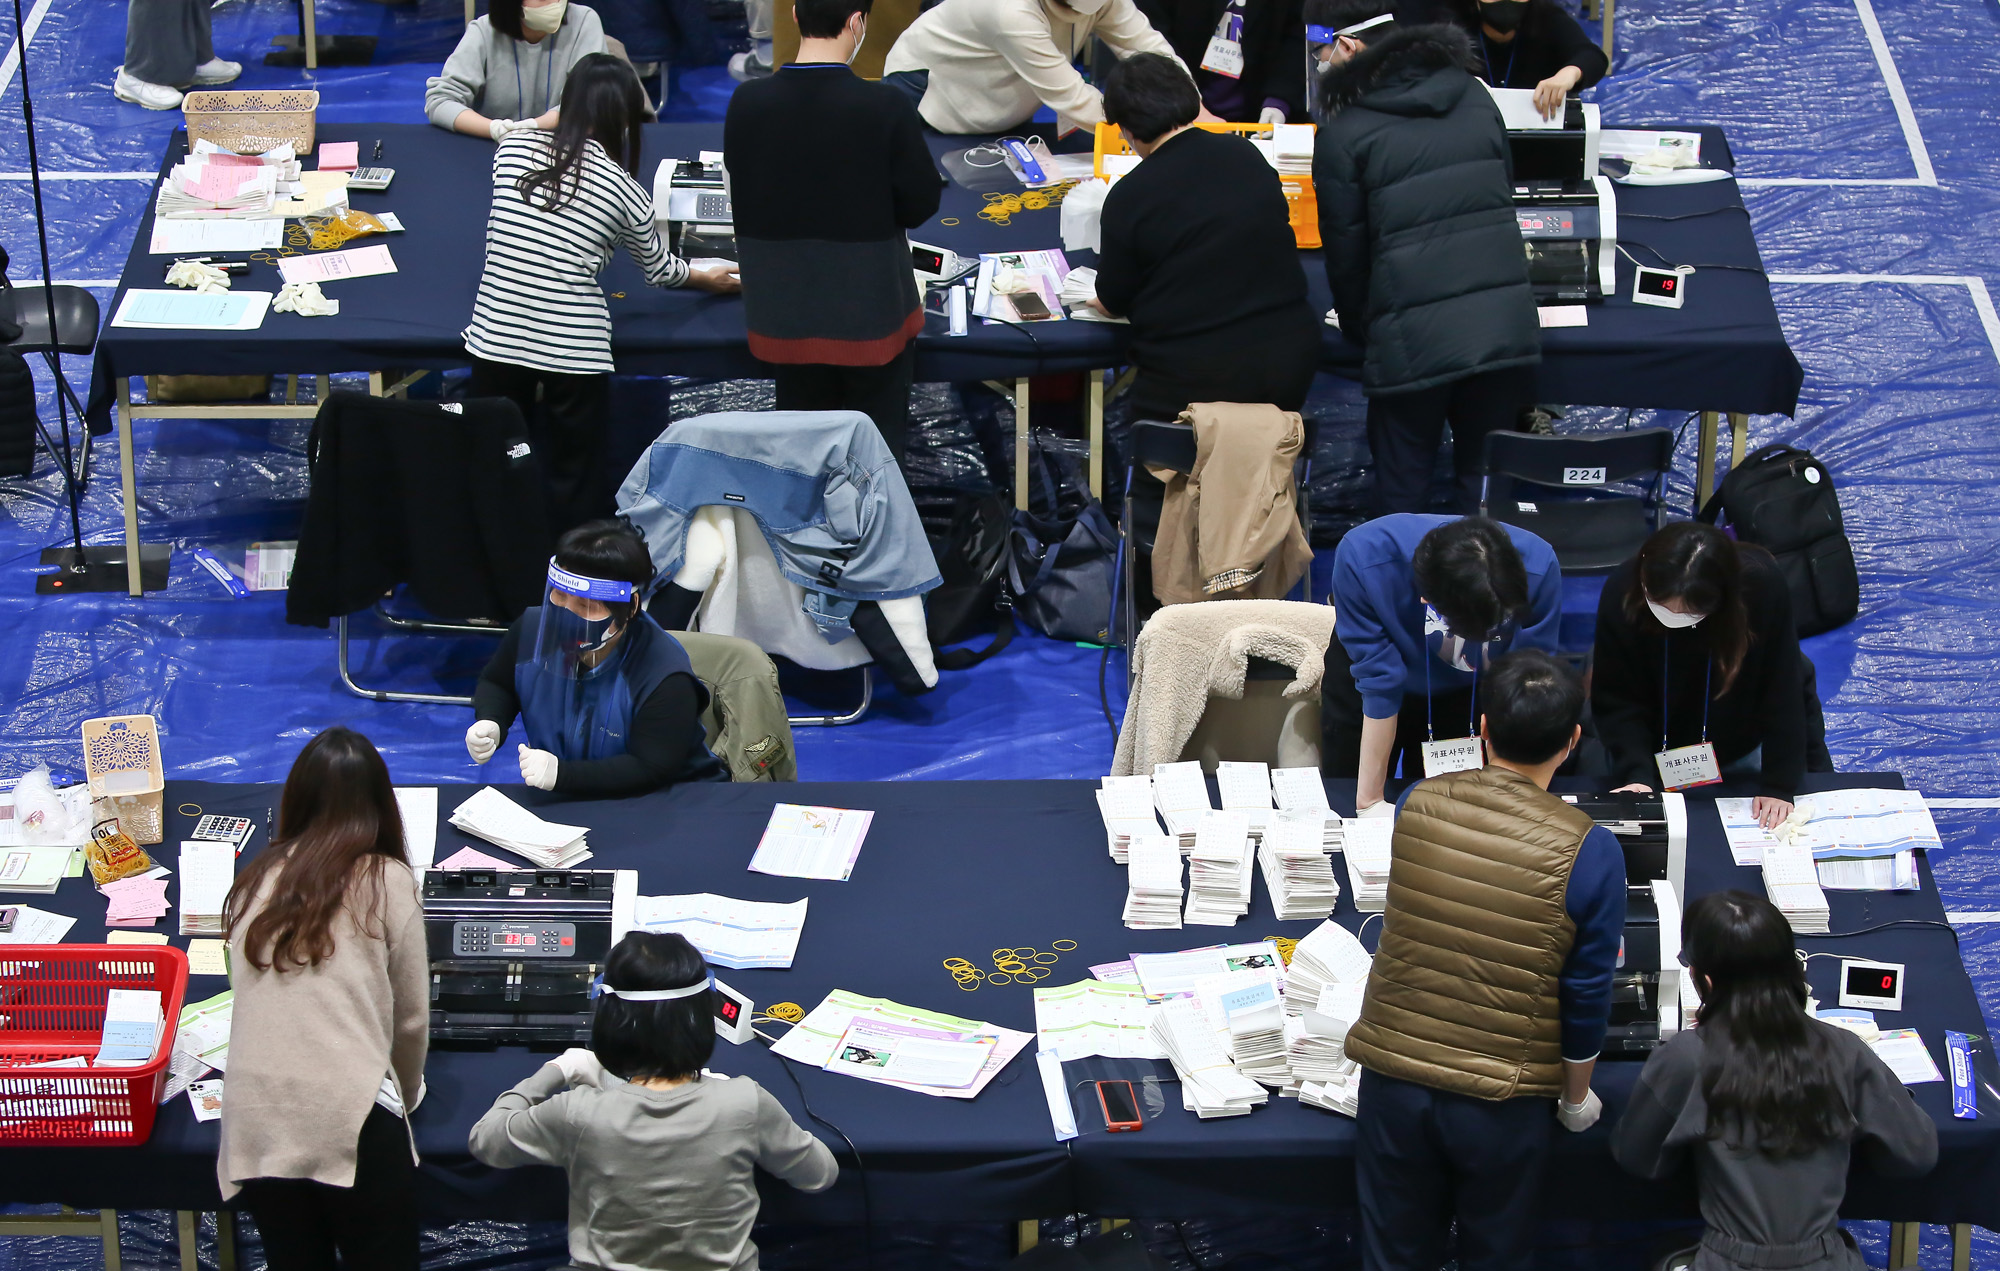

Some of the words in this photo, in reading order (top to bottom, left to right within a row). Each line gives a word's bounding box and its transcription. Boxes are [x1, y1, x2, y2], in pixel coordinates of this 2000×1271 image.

[934, 256, 940, 267] 7
[1662, 279, 1675, 291] 19
[1568, 469, 1602, 481] 224
[557, 573, 580, 587] Shield
[1430, 746, 1475, 759] 개표사무원
[1665, 753, 1708, 768] 개표사무원
[506, 934, 520, 944] 83
[1881, 975, 1893, 989] 0
[722, 1002, 738, 1019] 83
[1957, 1069, 1965, 1081] Face
